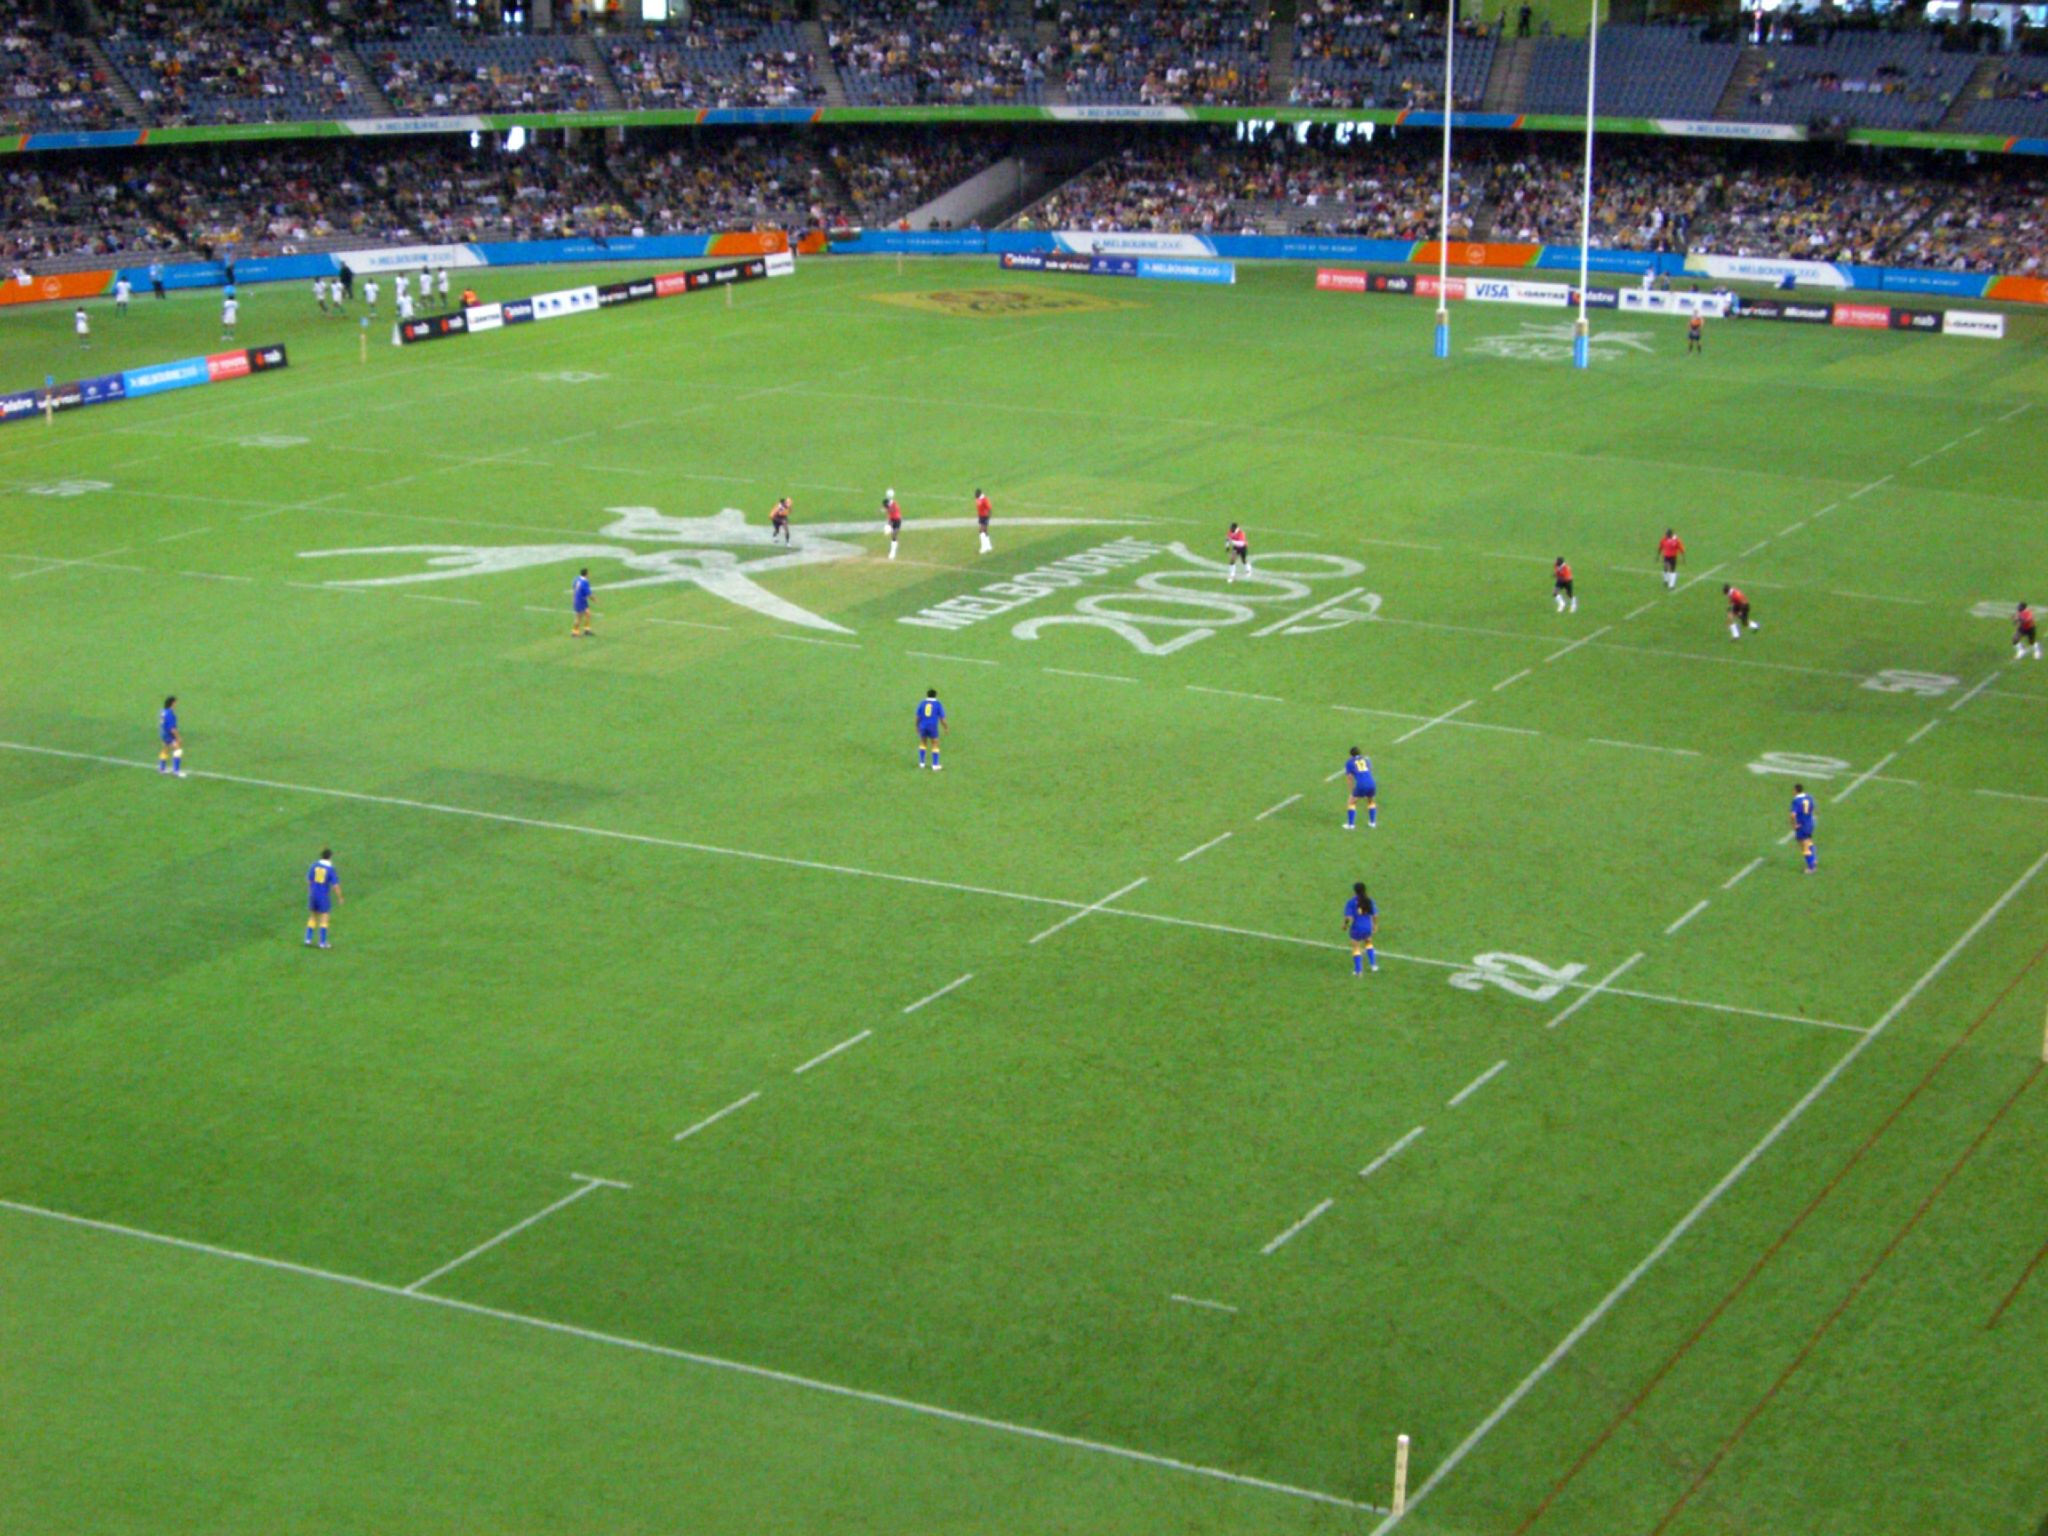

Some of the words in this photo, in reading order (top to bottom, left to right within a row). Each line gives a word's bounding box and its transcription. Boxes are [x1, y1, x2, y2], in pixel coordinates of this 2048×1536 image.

[1332, 275, 1366, 284] TOYOTA
[1387, 278, 1408, 290] nab
[1476, 283, 1510, 298] VISA
[1522, 289, 1565, 300] QANTAS
[1852, 311, 1887, 321] TOYOTA
[1911, 314, 1936, 326] nab
[1953, 318, 1999, 331] QANTAS
[897, 535, 1167, 630] MELBOURNE
[1012, 540, 1366, 656] 2006
[1448, 951, 1589, 1001] 22
